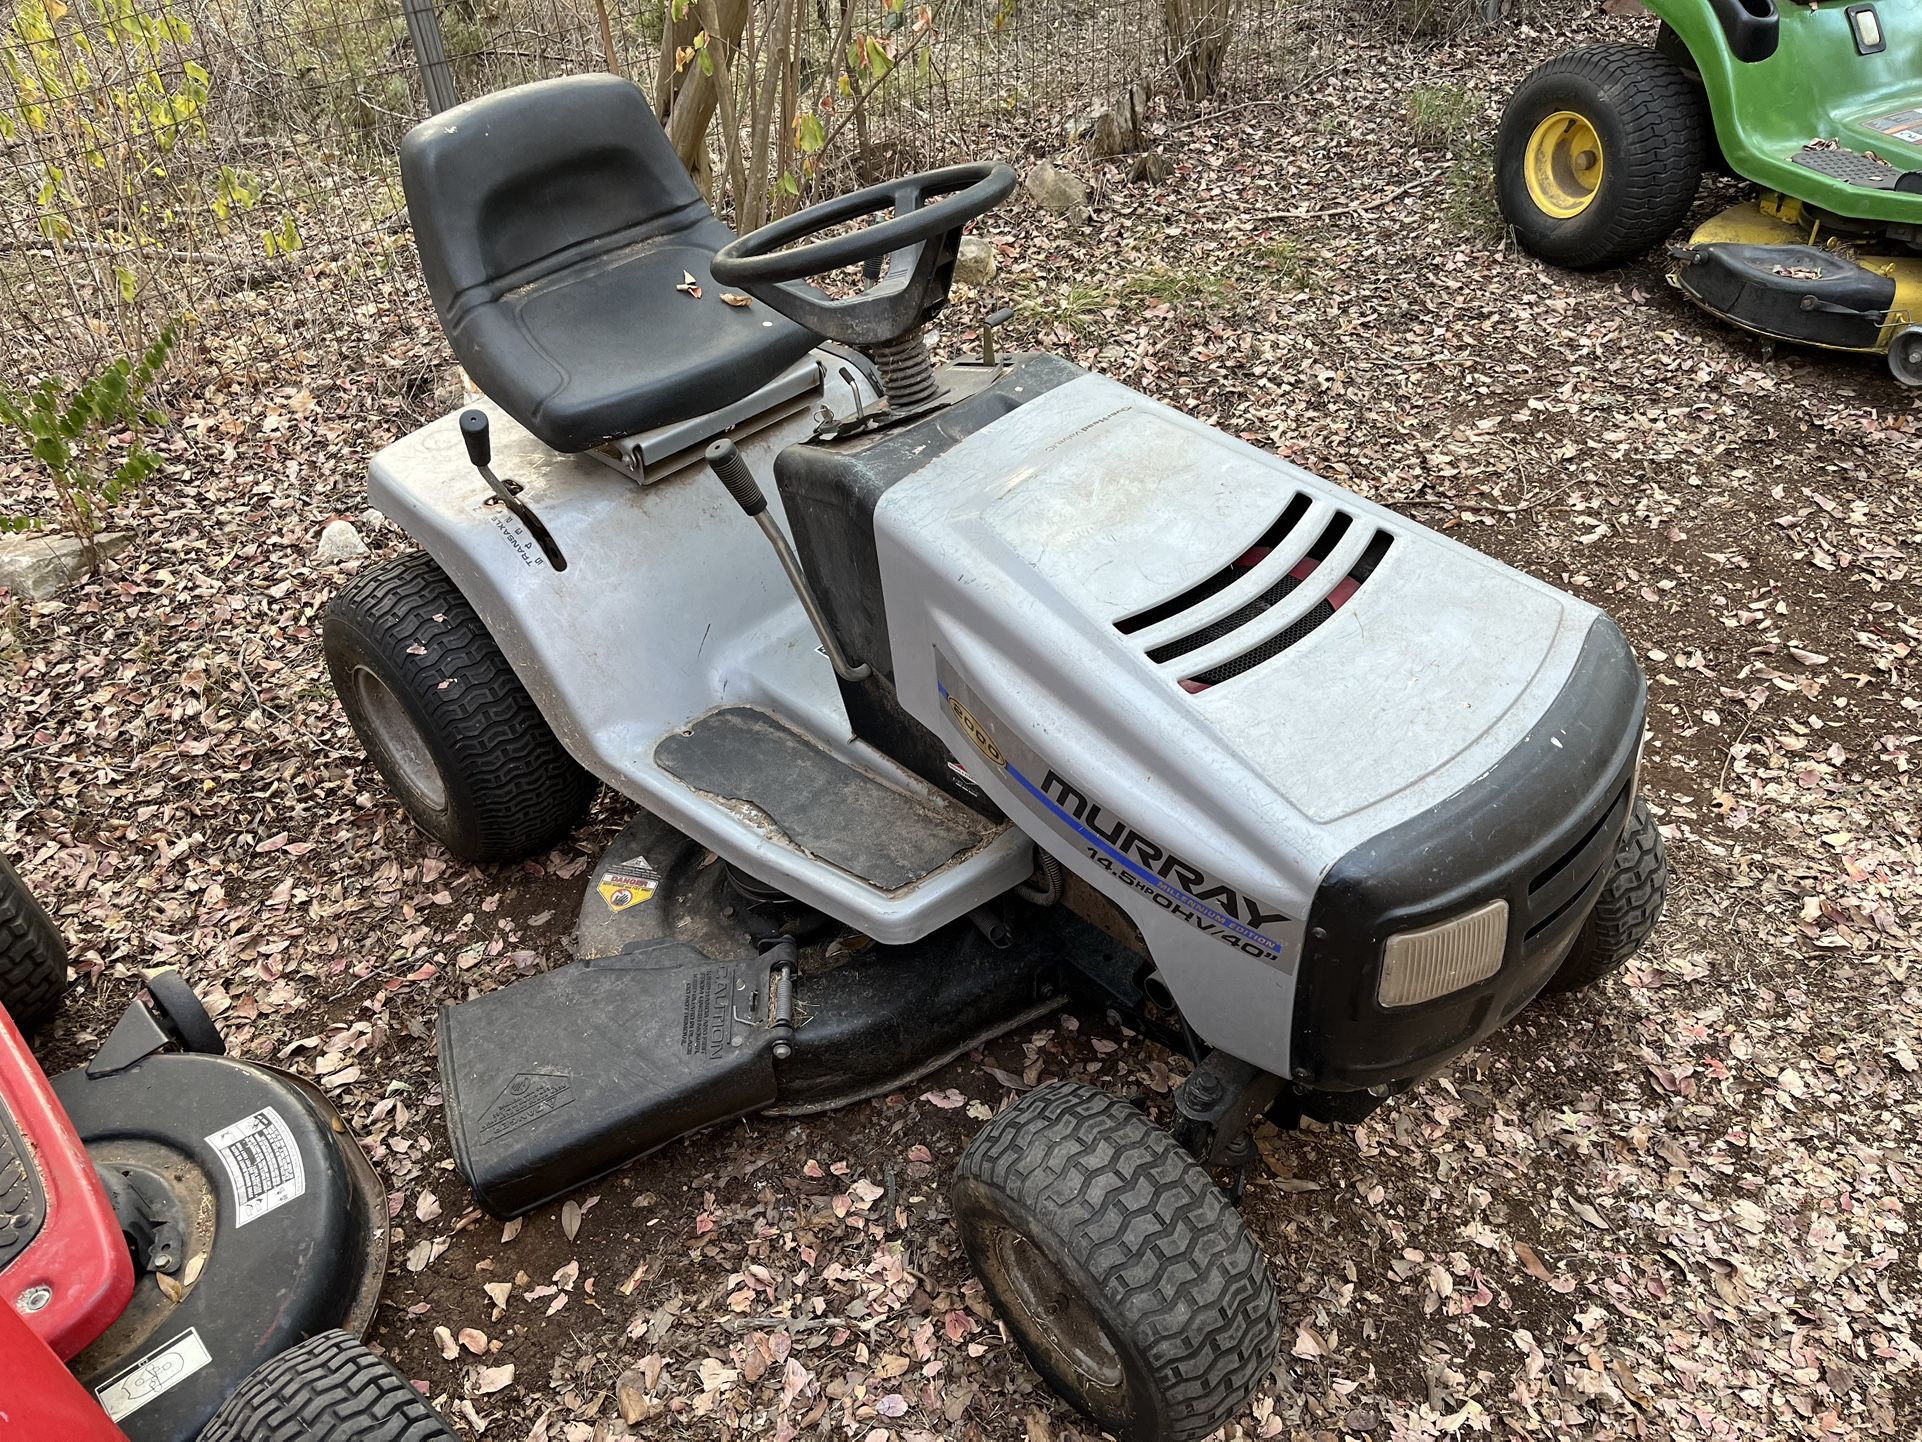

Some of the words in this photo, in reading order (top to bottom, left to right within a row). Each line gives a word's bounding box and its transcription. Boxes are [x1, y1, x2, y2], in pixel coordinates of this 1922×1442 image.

[490, 515, 533, 567] TRANSAXLE
[952, 700, 1001, 761] 2000
[611, 875, 649, 887] DANGER
[1040, 769, 1291, 929] MURRAY
[1156, 880, 1227, 925] MILLENNIUM
[1229, 922, 1277, 950] EDITION
[710, 966, 728, 1060] CAUTION
